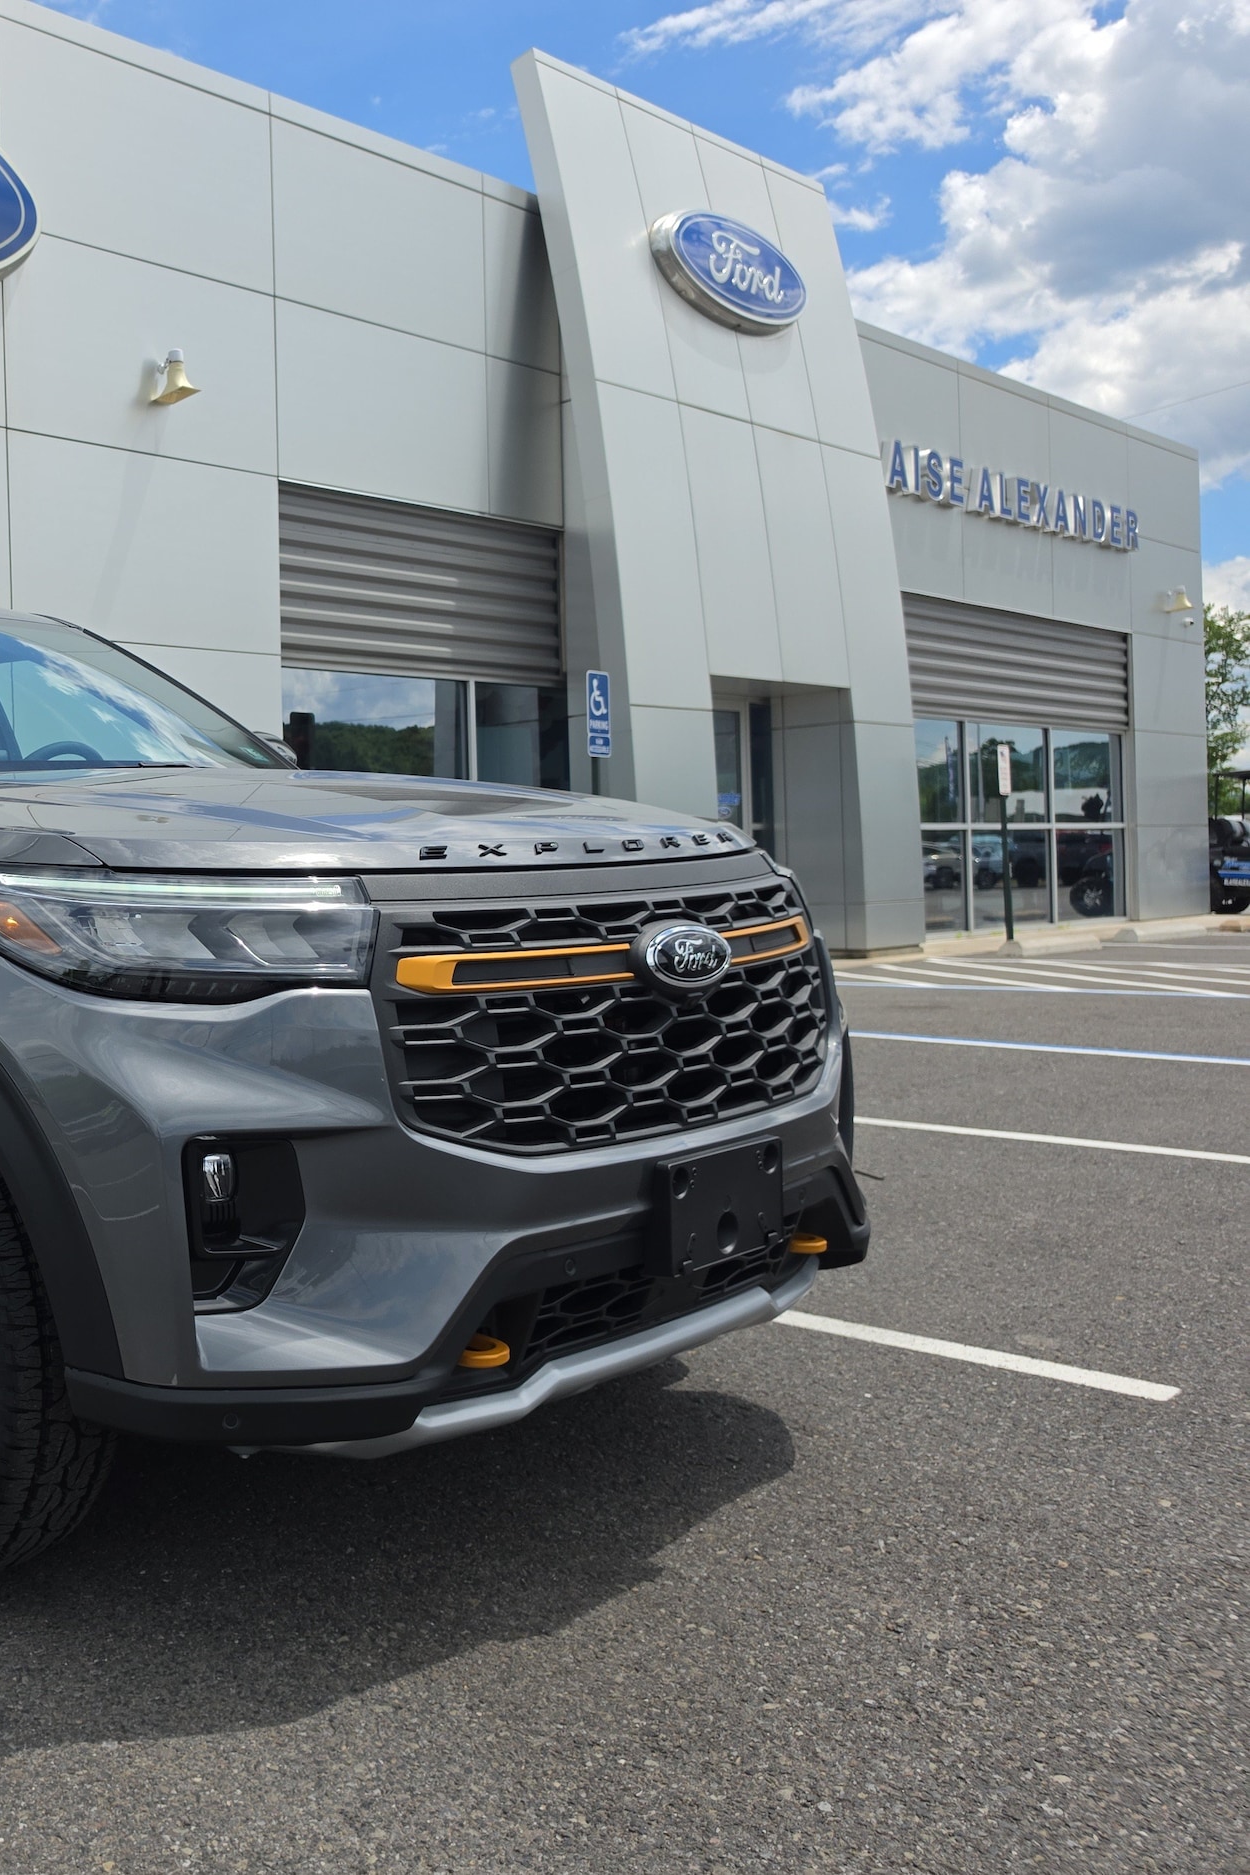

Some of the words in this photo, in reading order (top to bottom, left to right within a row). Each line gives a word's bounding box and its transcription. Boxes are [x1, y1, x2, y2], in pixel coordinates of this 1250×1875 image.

[709, 231, 785, 304] Ford
[978, 466, 1140, 551] ALEXANDER
[419, 831, 734, 861] EXPLORER
[674, 938, 718, 974] Ford
